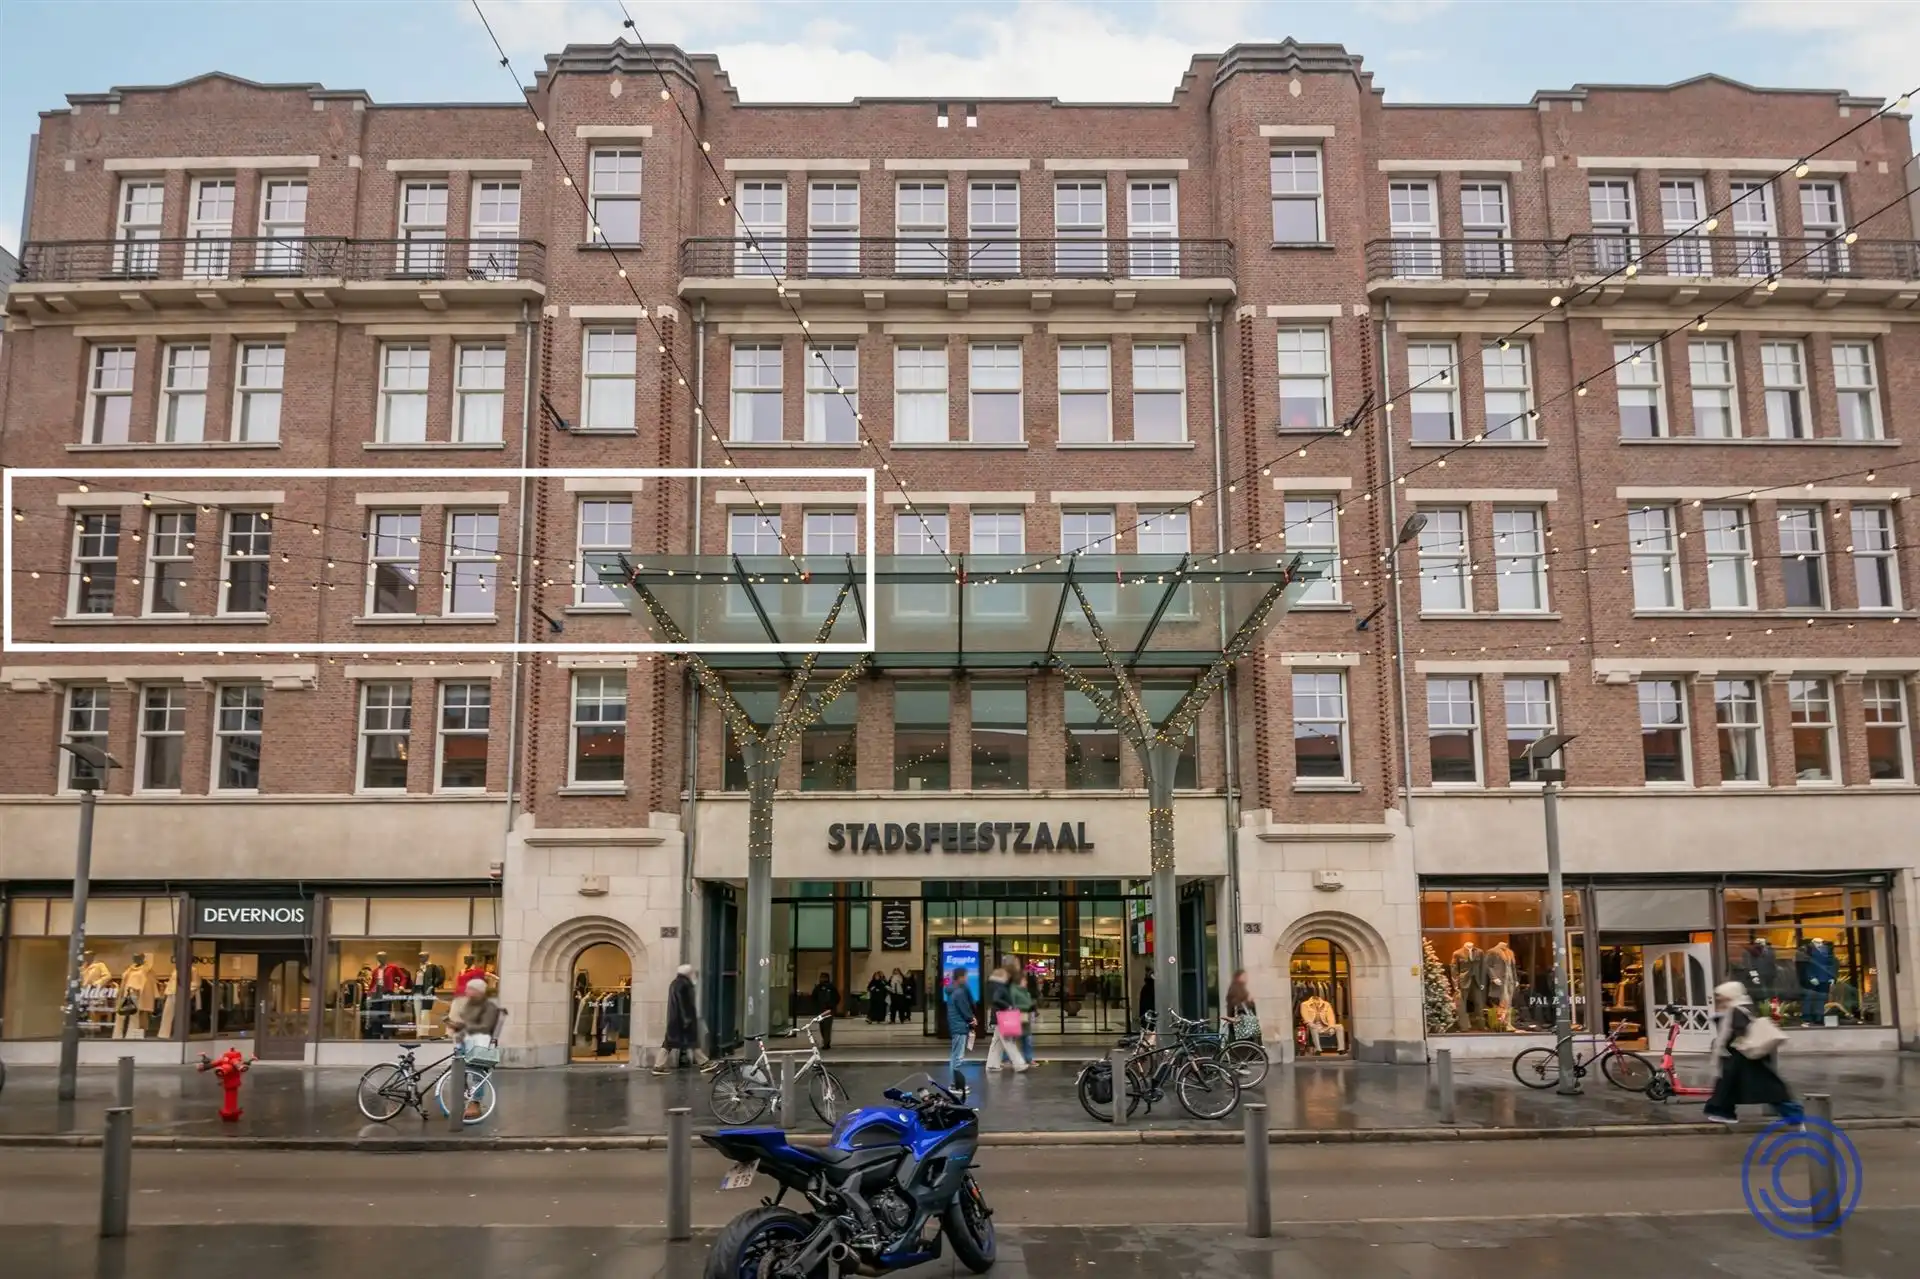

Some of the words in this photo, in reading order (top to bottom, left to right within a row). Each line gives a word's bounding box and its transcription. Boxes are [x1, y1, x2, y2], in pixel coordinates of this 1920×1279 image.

[828, 822, 1094, 853] STADSFEESTZAAL
[204, 908, 304, 922] DEVERNOIS
[1246, 924, 1260, 933] 33
[1529, 996, 1549, 1005] PAL
